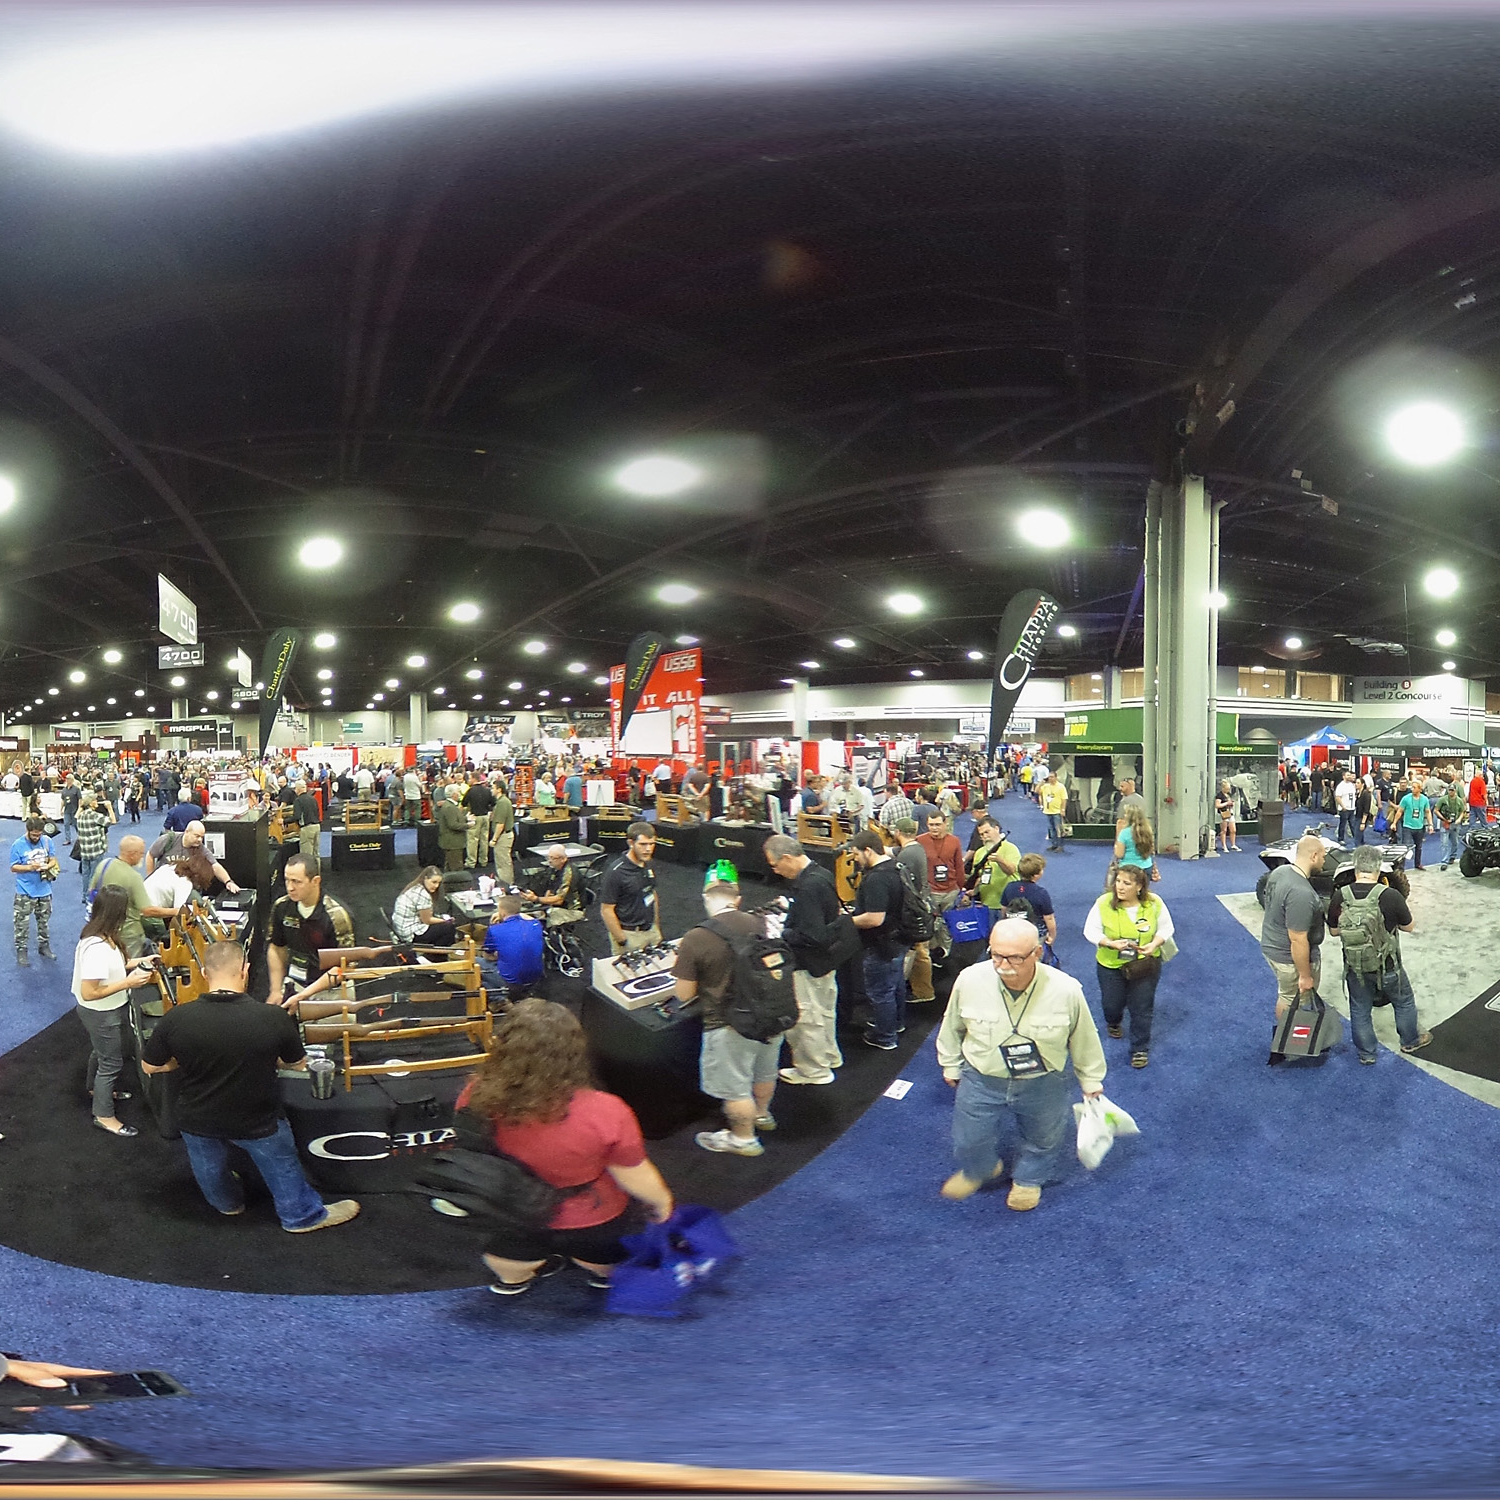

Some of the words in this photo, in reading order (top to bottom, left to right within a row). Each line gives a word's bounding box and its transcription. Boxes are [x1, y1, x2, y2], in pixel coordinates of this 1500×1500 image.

[161, 600, 196, 637] 4700
[1000, 600, 1053, 691] CHIAPPA
[161, 650, 200, 662] 4700
[265, 661, 284, 700] Charles
[278, 636, 293, 662] Daly
[1363, 680, 1398, 690] Building
[642, 694, 657, 706] IT
[665, 690, 696, 704] ALL
[1363, 691, 1386, 700] Level
[1387, 692, 1394, 700] 2
[1395, 692, 1443, 700] Concourse
[169, 725, 214, 733] MAGPUL
[1358, 746, 1394, 756] CanCooker.com
[1423, 747, 1471, 758] CanCooker.com
[308, 1126, 457, 1161] CHIA
